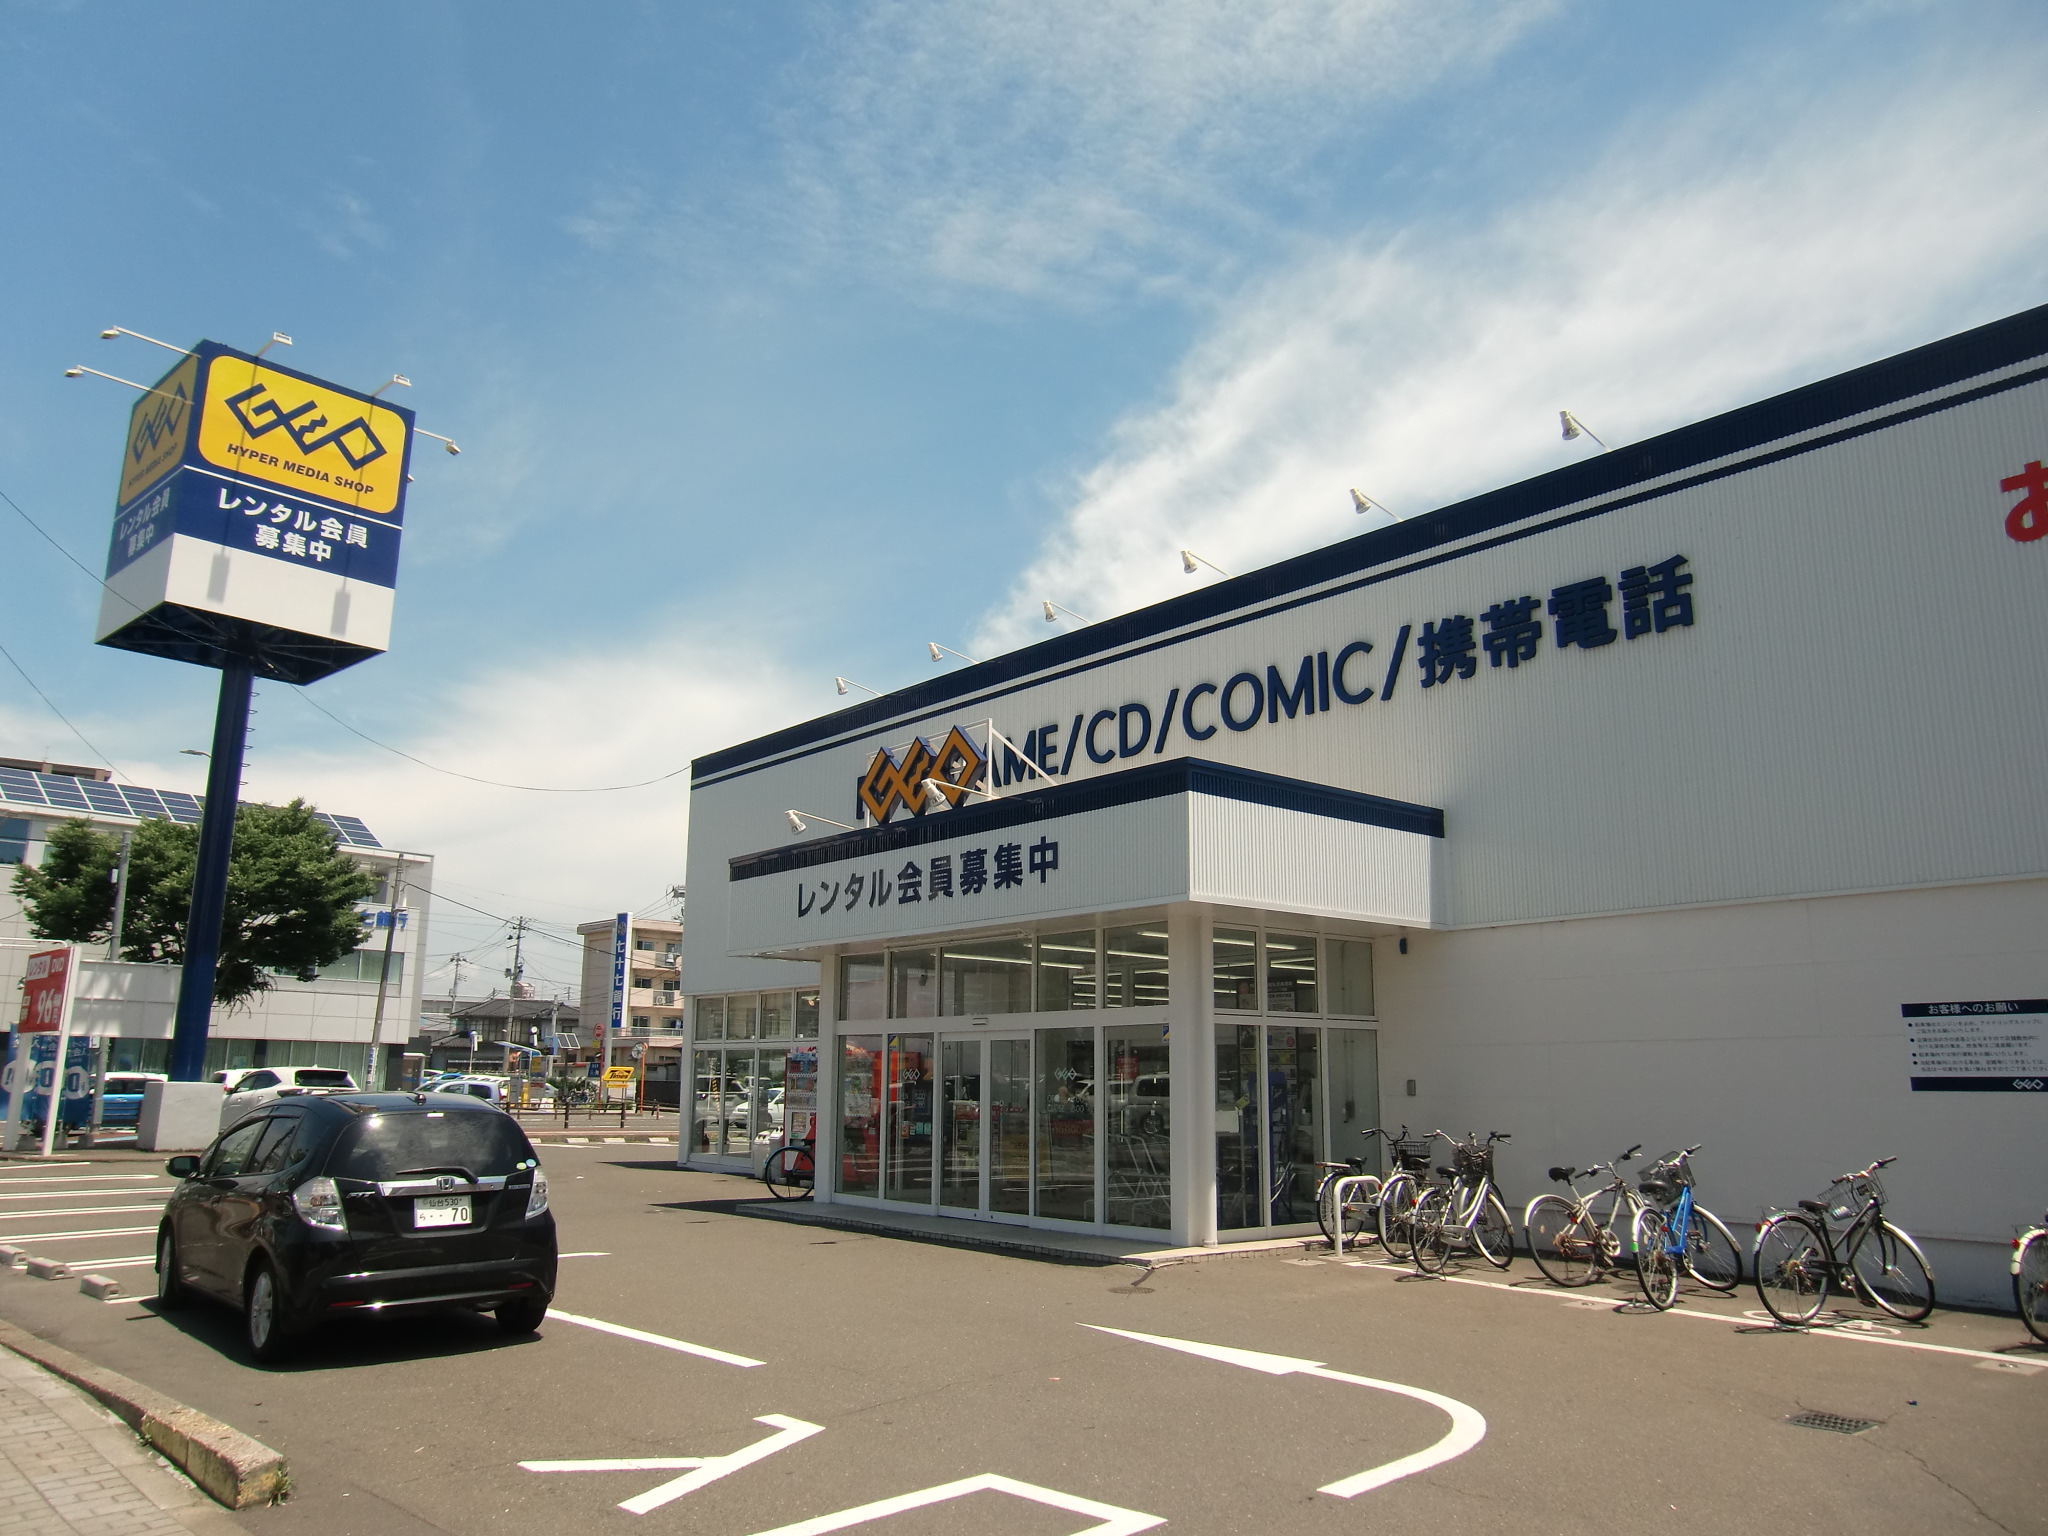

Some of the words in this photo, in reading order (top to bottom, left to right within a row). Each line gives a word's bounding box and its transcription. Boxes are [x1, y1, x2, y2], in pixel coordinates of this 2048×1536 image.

[227, 442, 279, 467] HYPER
[283, 458, 330, 482] MEDIA
[334, 476, 375, 495] SHOP
[218, 488, 367, 549] レンタル会員
[255, 523, 331, 563] 募集中
[798, 836, 1059, 917] レンタル会員募集中
[612, 940, 625, 1020] 七十七銀行
[1928, 1002, 2019, 1015] お客様へのお願い
